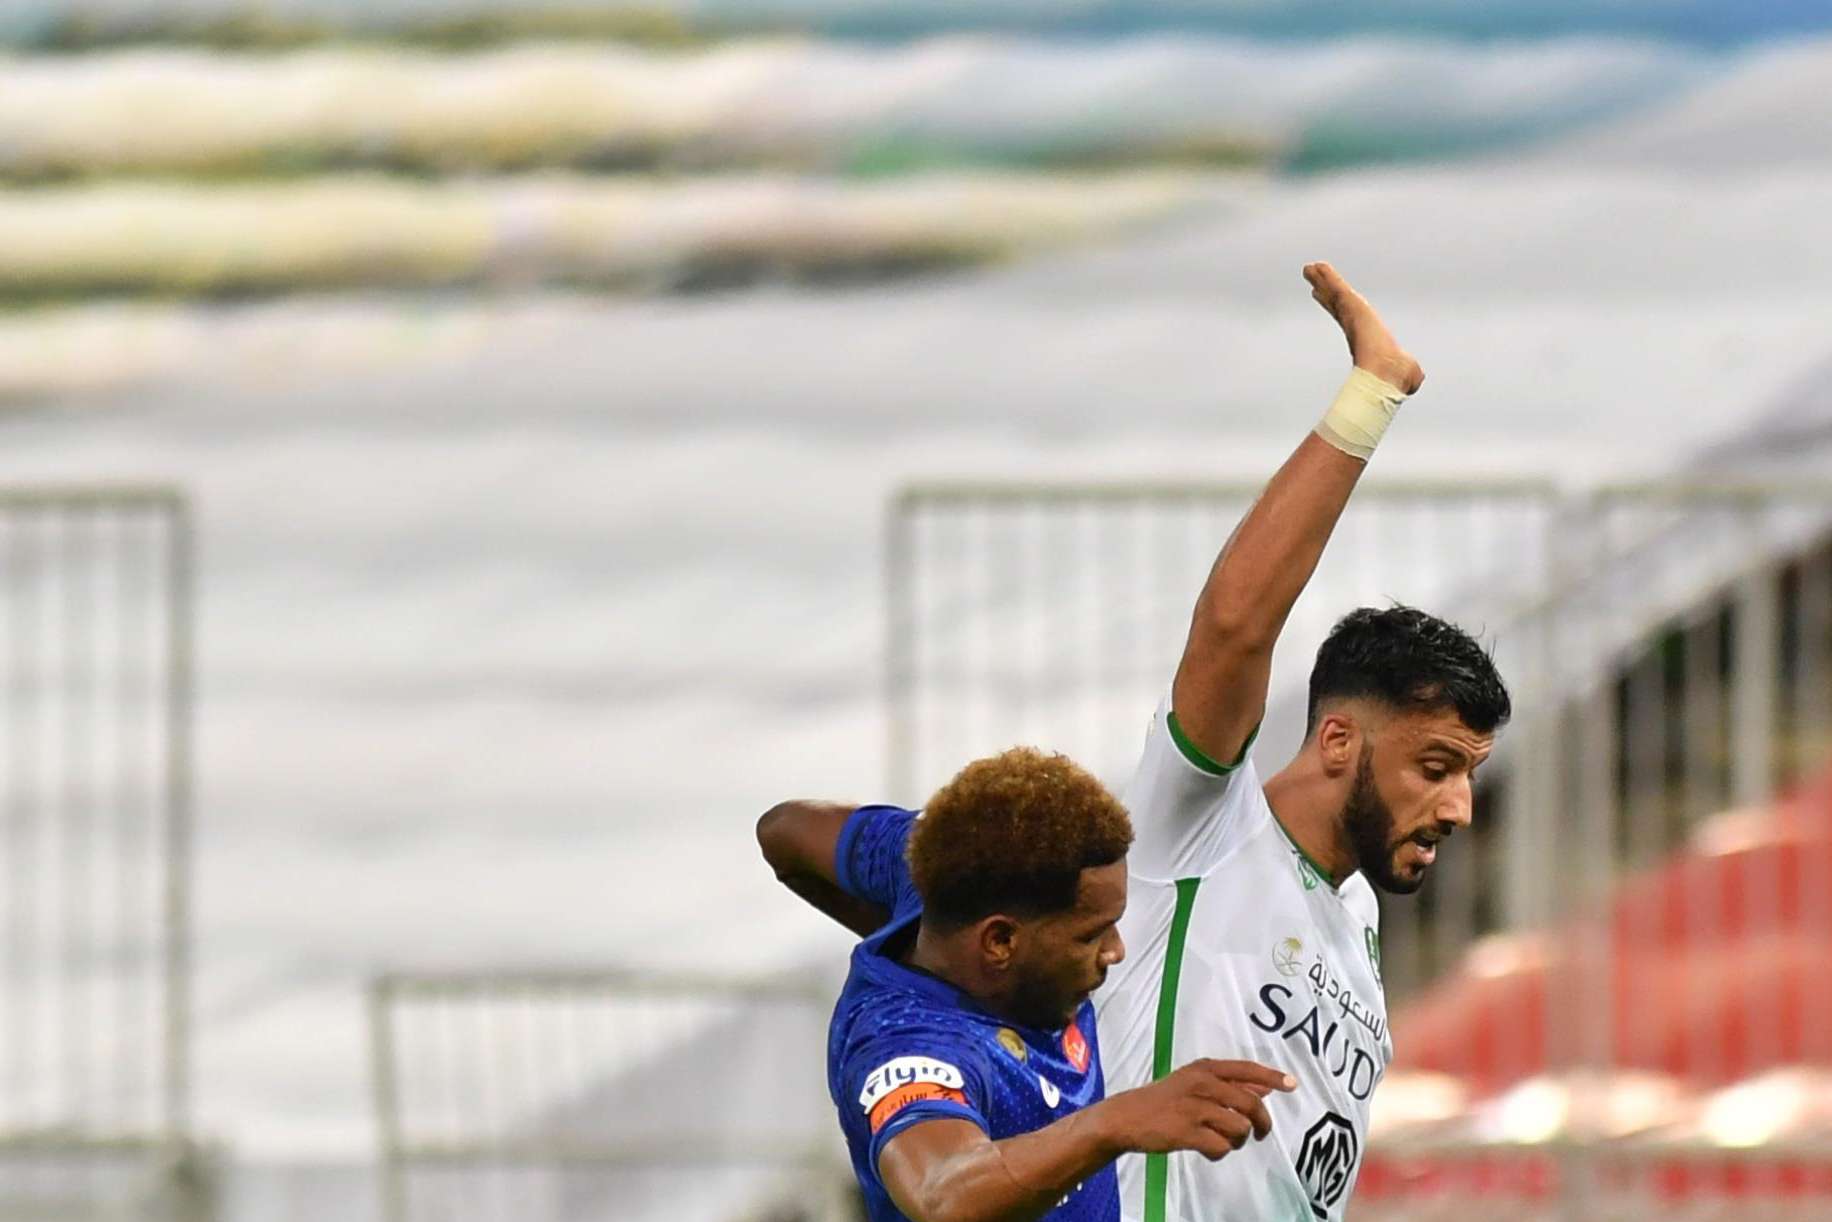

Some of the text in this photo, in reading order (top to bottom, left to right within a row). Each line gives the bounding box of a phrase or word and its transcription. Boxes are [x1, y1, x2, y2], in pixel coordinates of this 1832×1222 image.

[1307, 952, 1386, 1042] لسعودية
[865, 1065, 953, 1097] Flyin
[1249, 982, 1375, 1101] SAUD
[1303, 1125, 1352, 1206] MG
